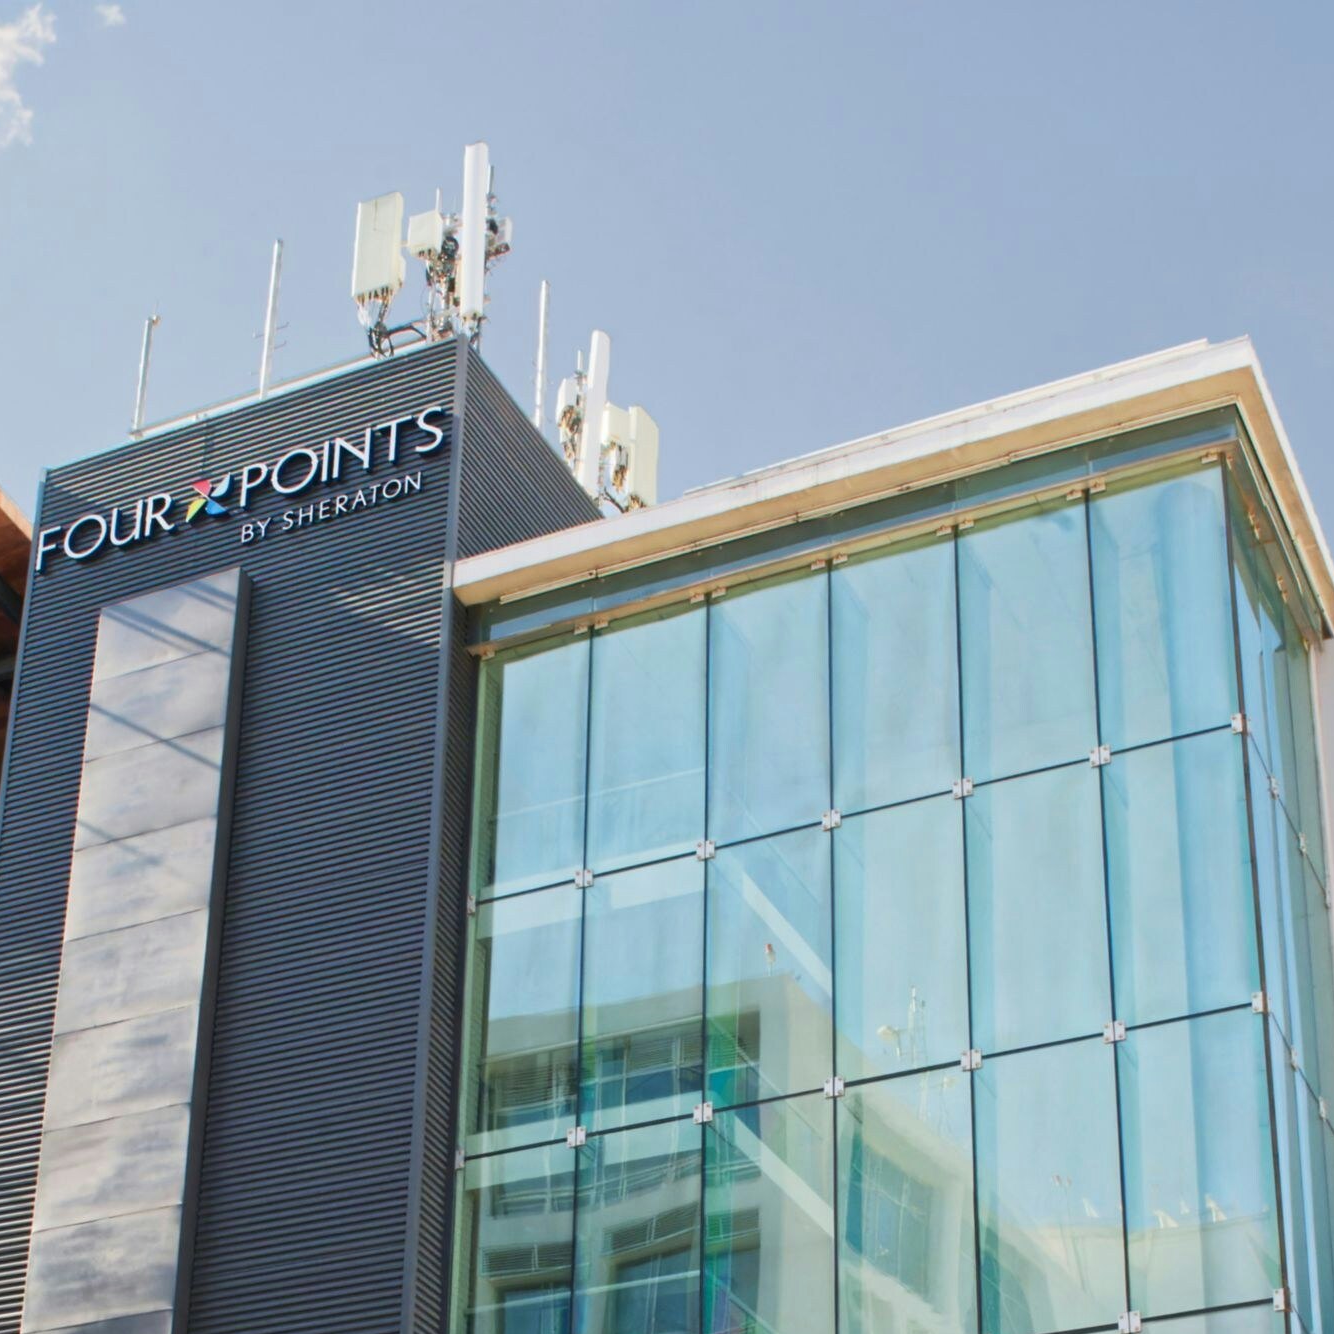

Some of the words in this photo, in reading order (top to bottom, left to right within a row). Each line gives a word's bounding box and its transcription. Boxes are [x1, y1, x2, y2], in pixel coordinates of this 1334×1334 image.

[35, 492, 175, 573] FOUR
[239, 406, 446, 509] POINTS
[240, 516, 273, 544] BY
[282, 471, 424, 532] SHERATON
